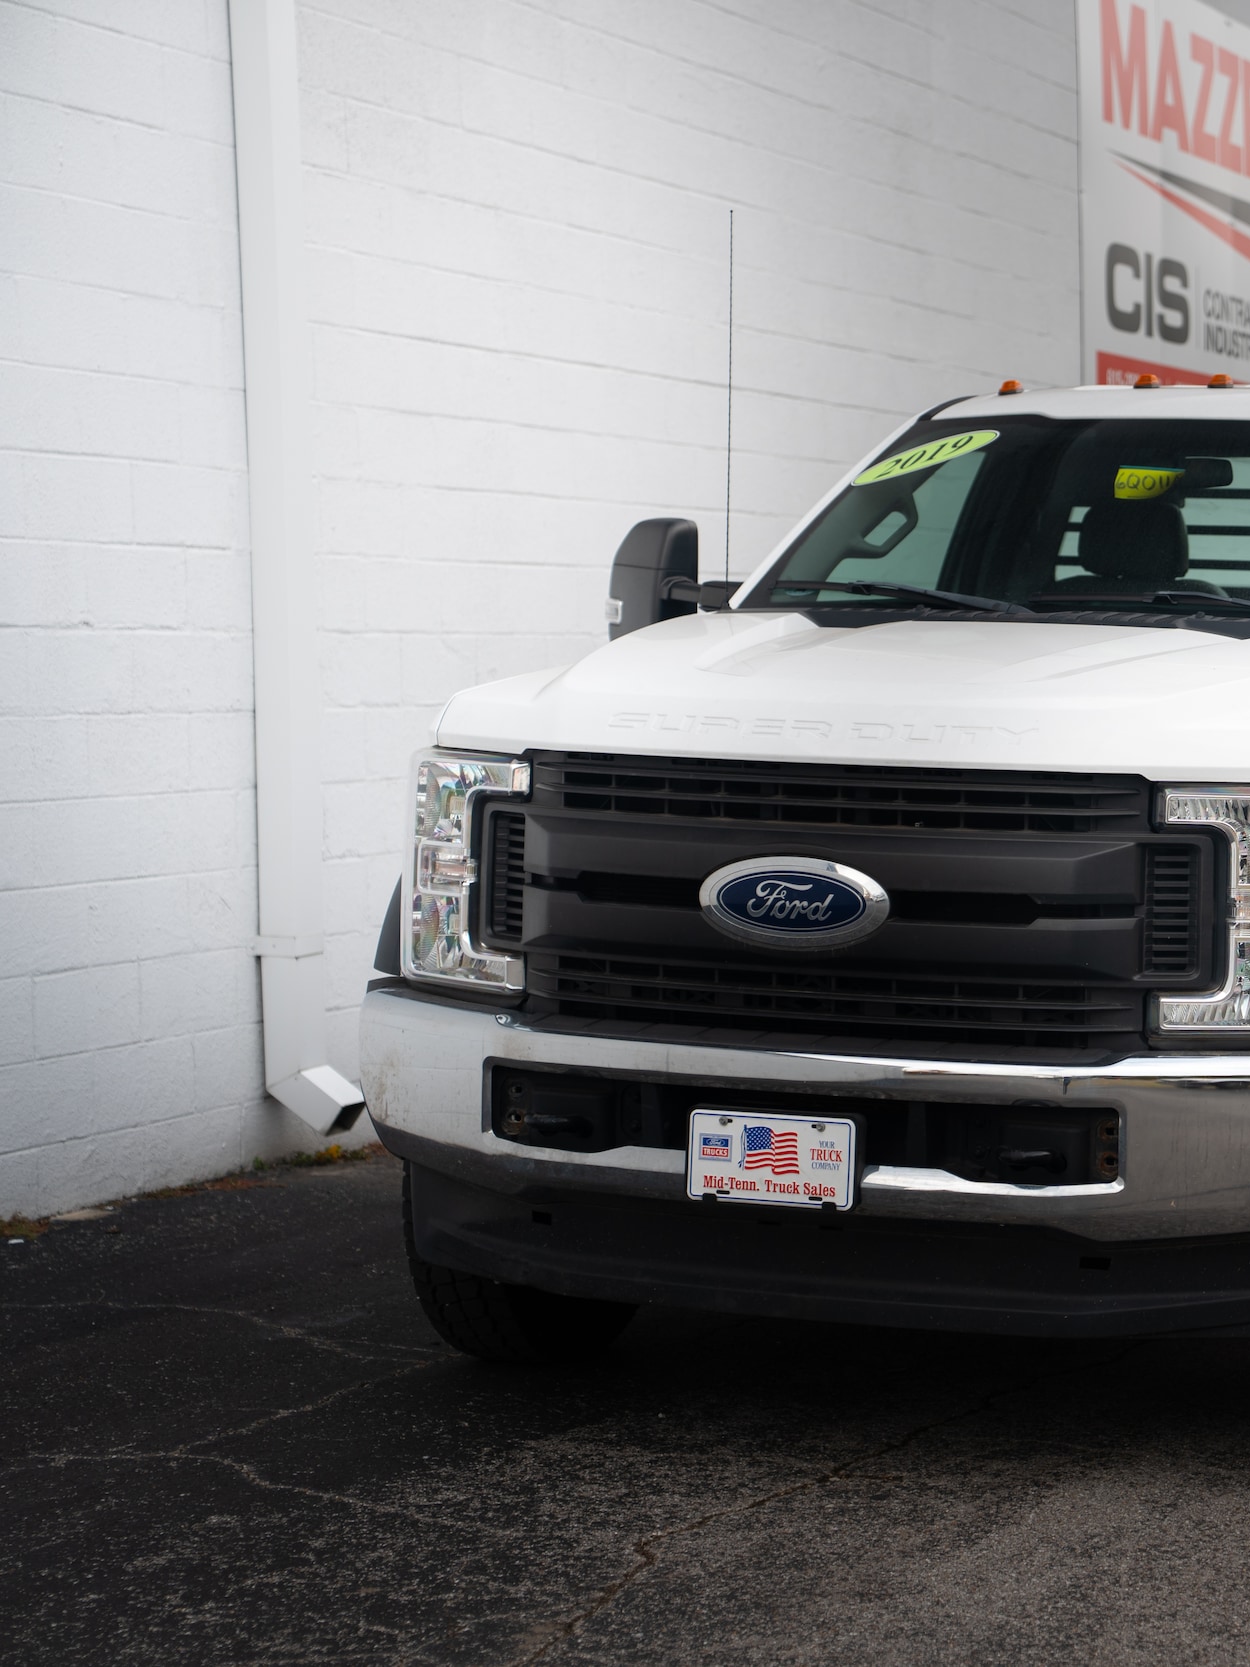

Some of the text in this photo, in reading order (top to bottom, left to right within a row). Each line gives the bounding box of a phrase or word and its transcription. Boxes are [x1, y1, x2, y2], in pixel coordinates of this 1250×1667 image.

[1105, 242, 1190, 345] CIS
[874, 435, 973, 479] 2019
[608, 711, 1039, 745] SUPER DUTY
[747, 880, 835, 922] Ford
[703, 1147, 728, 1157] TRUCKS
[810, 1148, 842, 1162] TRUCK
[818, 1140, 835, 1149] YOUR
[811, 1161, 841, 1171] COMPANY
[703, 1175, 836, 1197] Mid-Tenn. Truck Sales
